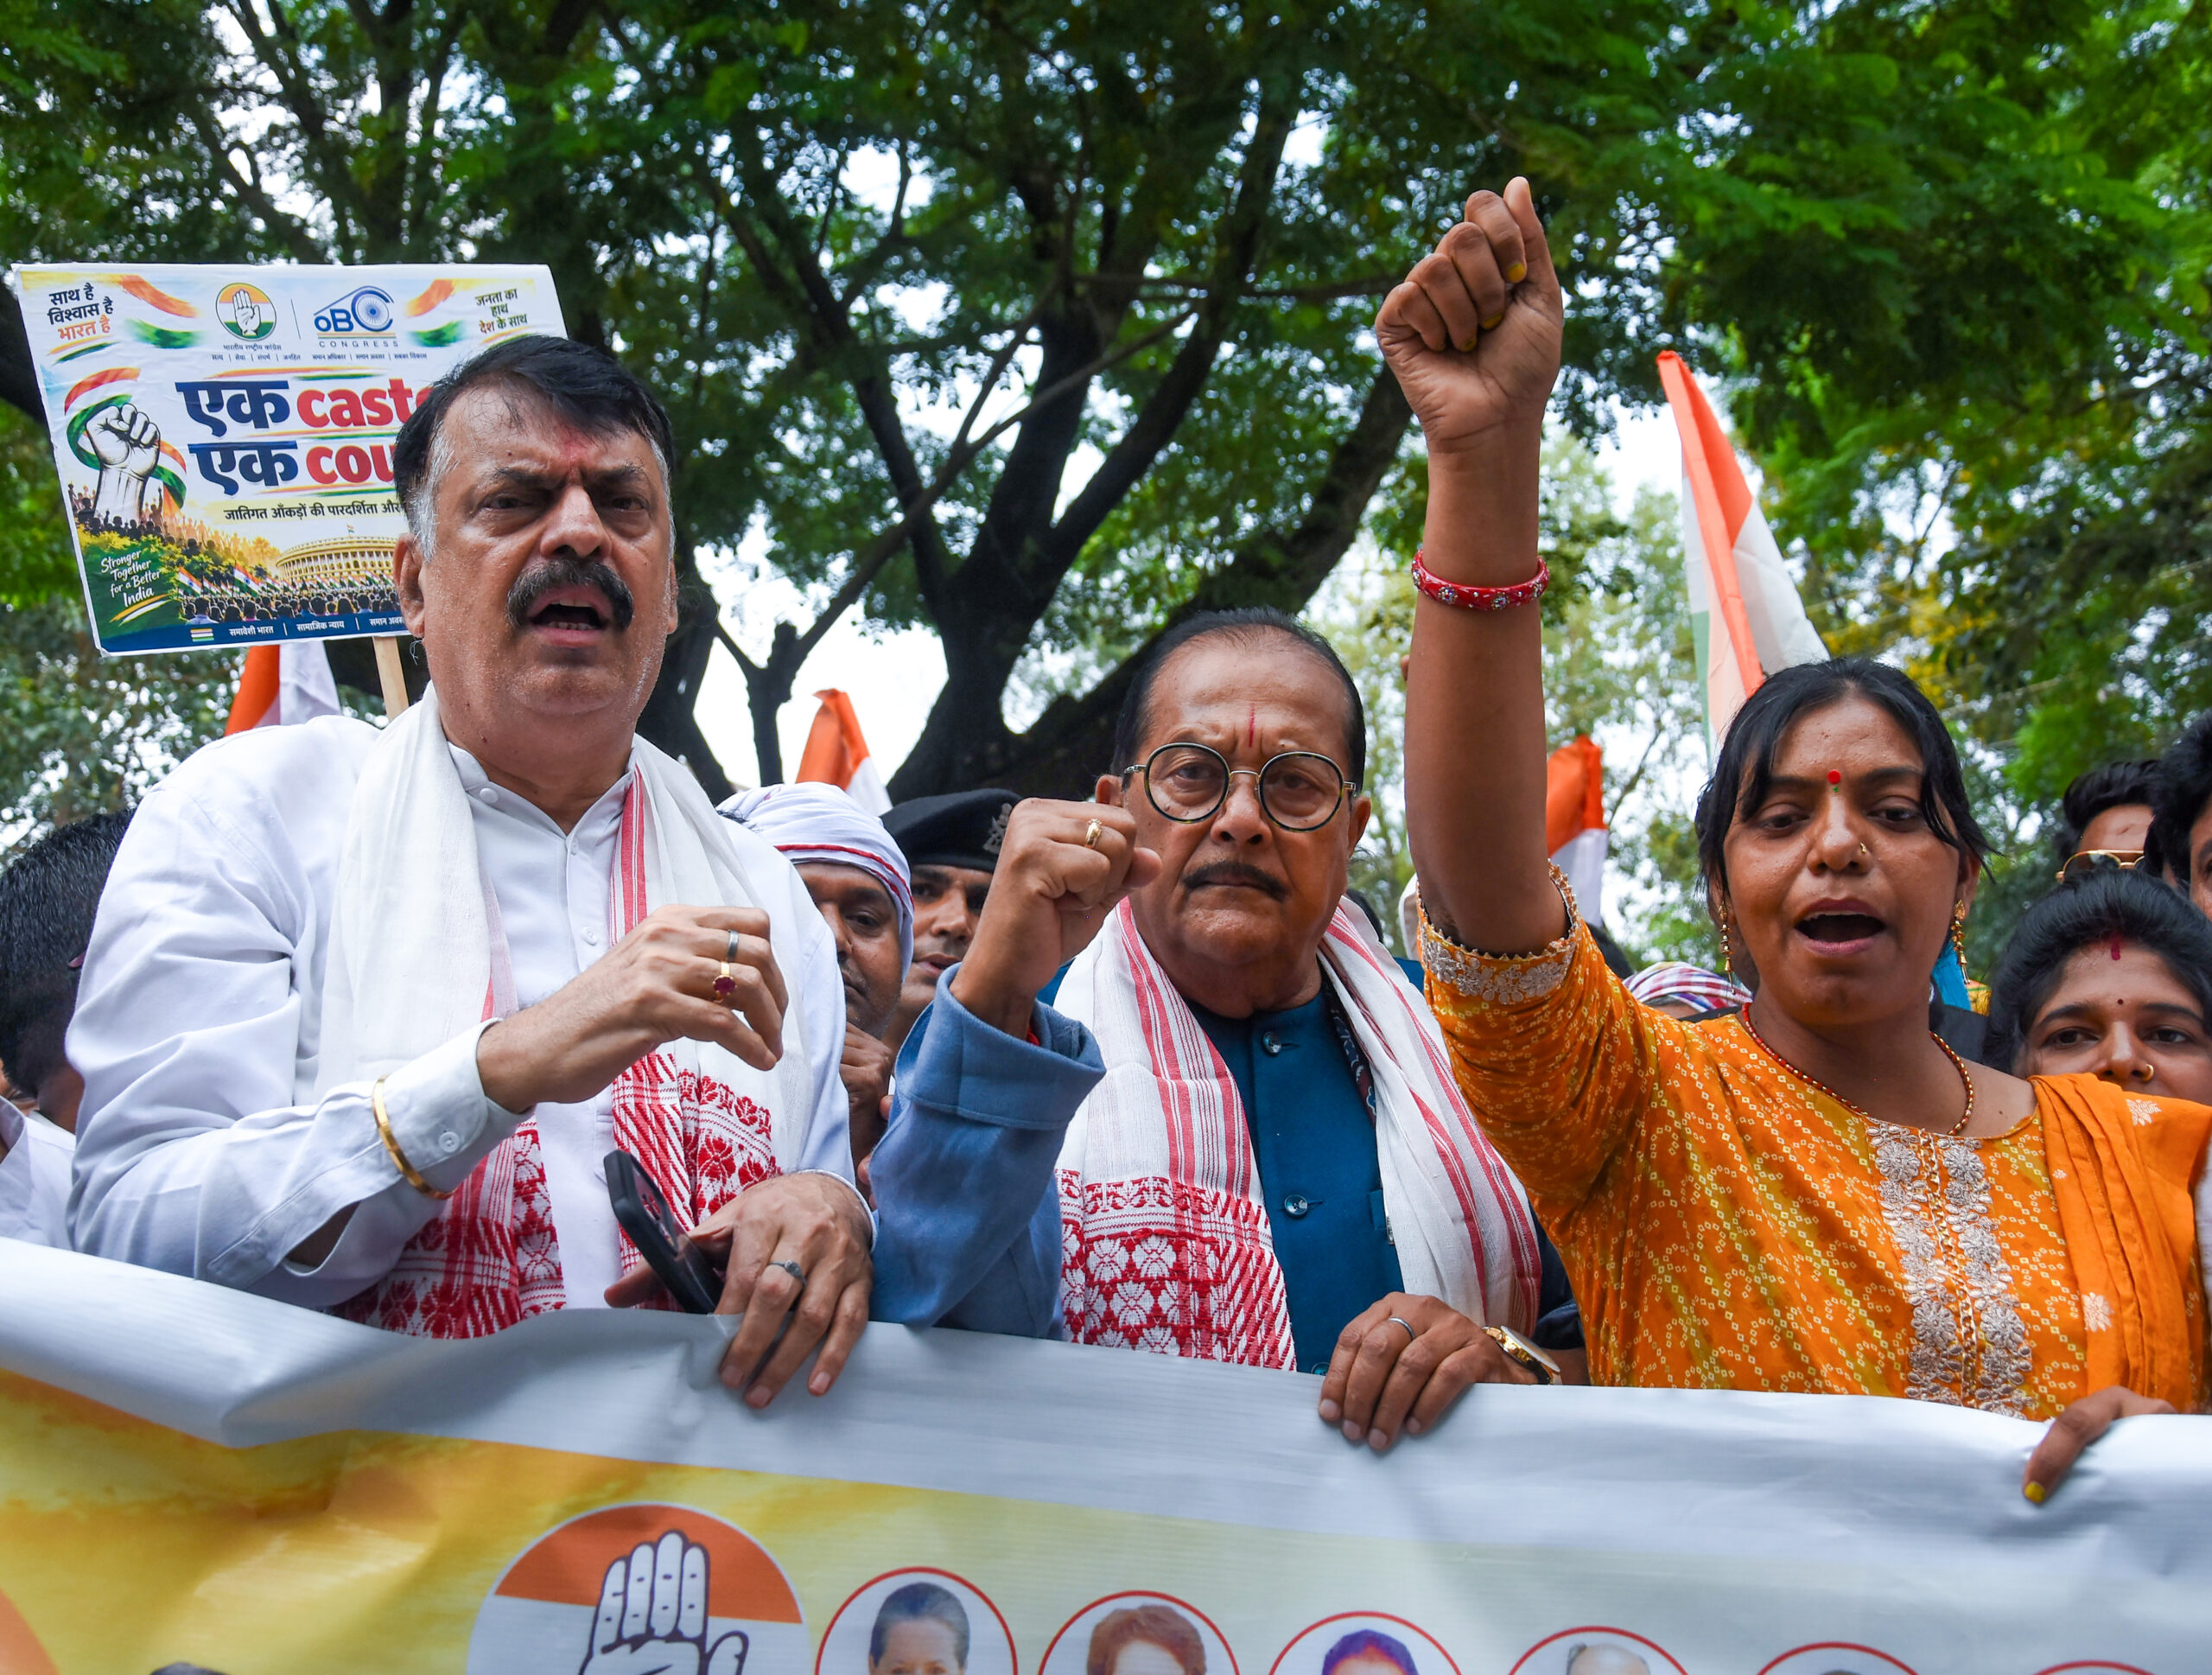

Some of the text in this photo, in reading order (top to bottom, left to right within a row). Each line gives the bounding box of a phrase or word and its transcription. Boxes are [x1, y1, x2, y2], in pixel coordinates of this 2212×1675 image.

[49, 283, 95, 305] साथ है
[475, 288, 518, 306] जनता का
[48, 296, 114, 325] विश्वास है
[490, 303, 509, 316] हाथ
[58, 315, 111, 341] भारत है
[479, 314, 528, 334] देश के साथ
[175, 380, 290, 437] एक
[188, 440, 299, 496] एक
[224, 499, 401, 520] जातिगत आँकड़ों की पारदर्शिता और
[100, 550, 142, 573] Stronger
[110, 559, 152, 582] Together
[110, 582, 124, 598] for
[131, 570, 161, 588] Better
[123, 587, 154, 607] India
[229, 624, 256, 637] समावेशी
[257, 625, 274, 634] भारत
[296, 621, 327, 632] सामाजिक
[328, 620, 345, 629] न्याय
[369, 617, 387, 626] समान
